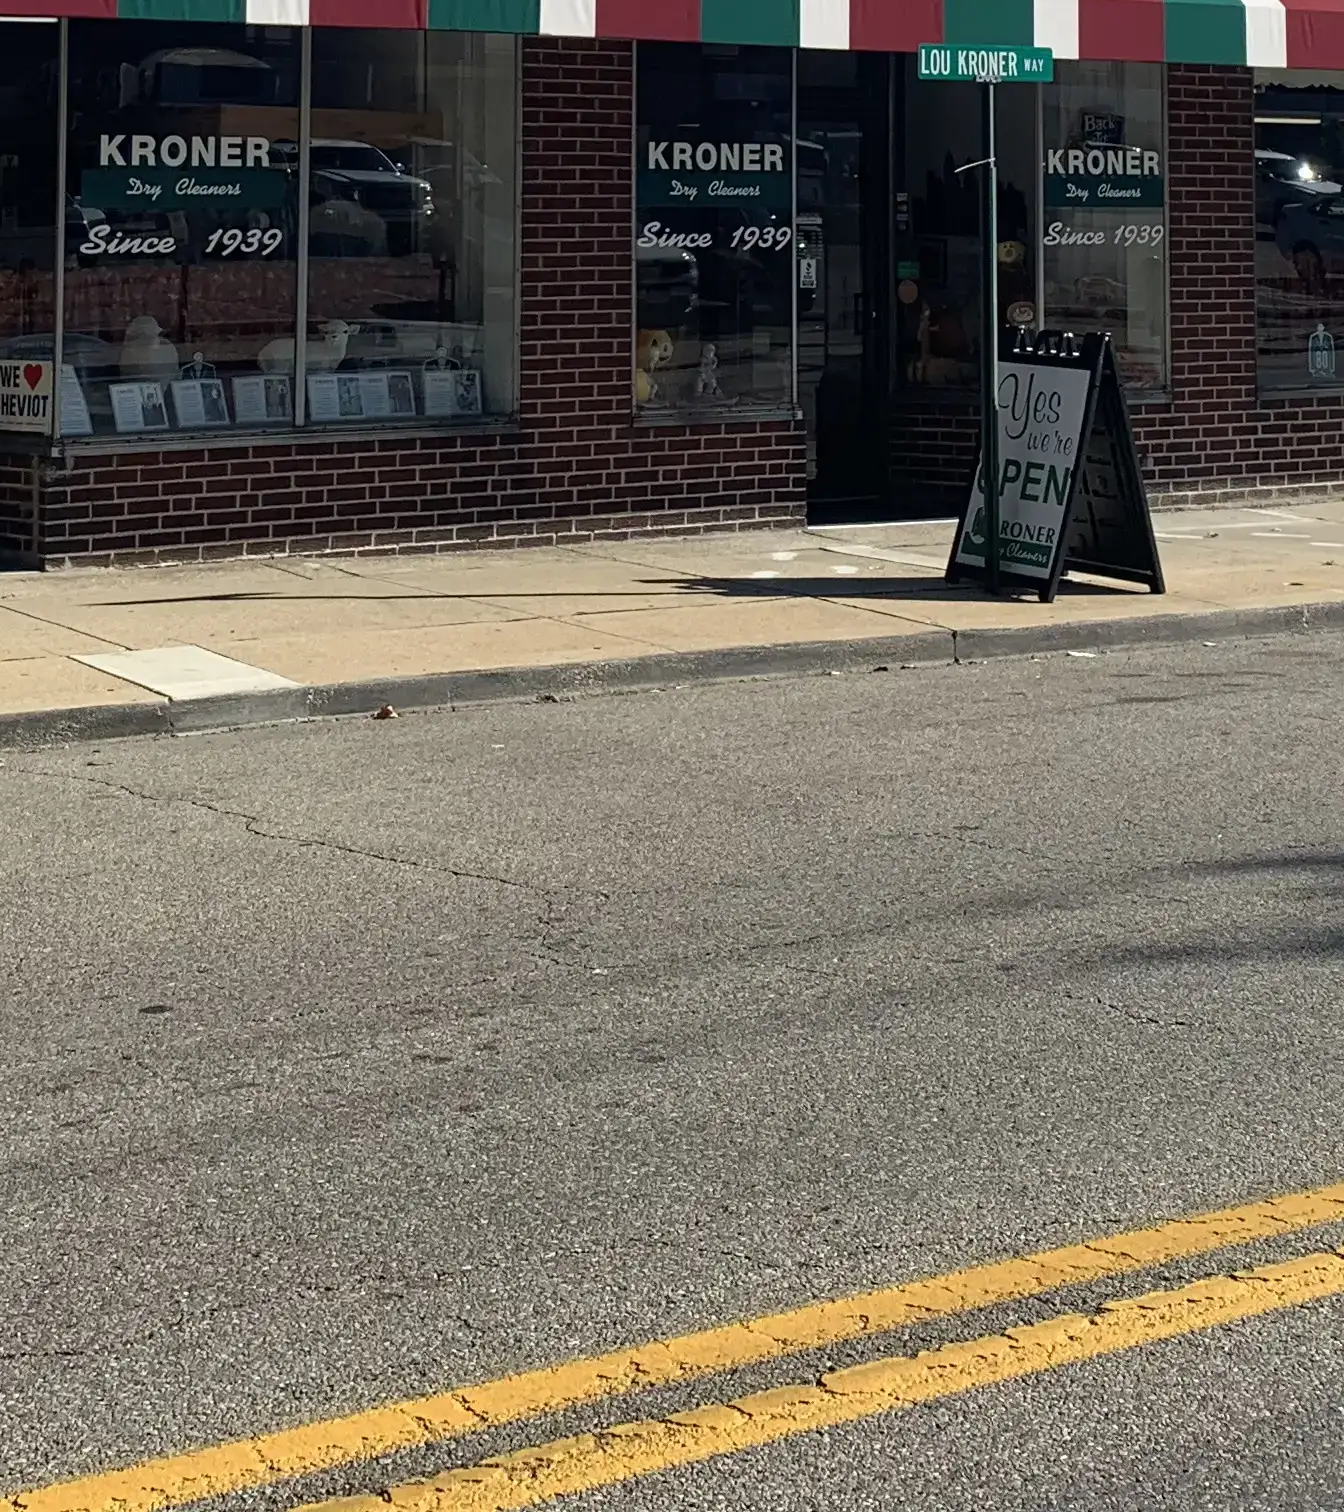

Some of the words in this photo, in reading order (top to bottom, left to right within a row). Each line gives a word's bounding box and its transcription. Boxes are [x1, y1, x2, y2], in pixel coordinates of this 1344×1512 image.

[920, 48, 951, 76] LOU
[957, 49, 1018, 77] KRONER
[1023, 58, 1044, 73] WAY
[99, 134, 271, 168] KRONER
[647, 141, 784, 172] KRONER
[1047, 149, 1160, 176] KRONER
[125, 177, 163, 201] Dry
[174, 178, 242, 196] Cleaners
[669, 179, 698, 201] Dry
[707, 180, 761, 196] Cleaners
[1065, 183, 1090, 202] Dry
[1097, 183, 1142, 198] Cleaners
[79, 224, 177, 255] Since
[205, 228, 283, 257] 1939
[636, 221, 713, 248] Since
[729, 225, 792, 252] 1939
[1043, 221, 1106, 246] Since
[1113, 224, 1165, 247] 1939
[0, 365, 21, 388] WE
[997, 372, 1062, 440] Yes
[1027, 430, 1073, 456] we're
[999, 519, 1057, 545] RONER
[1006, 541, 1050, 564] Cleaners
